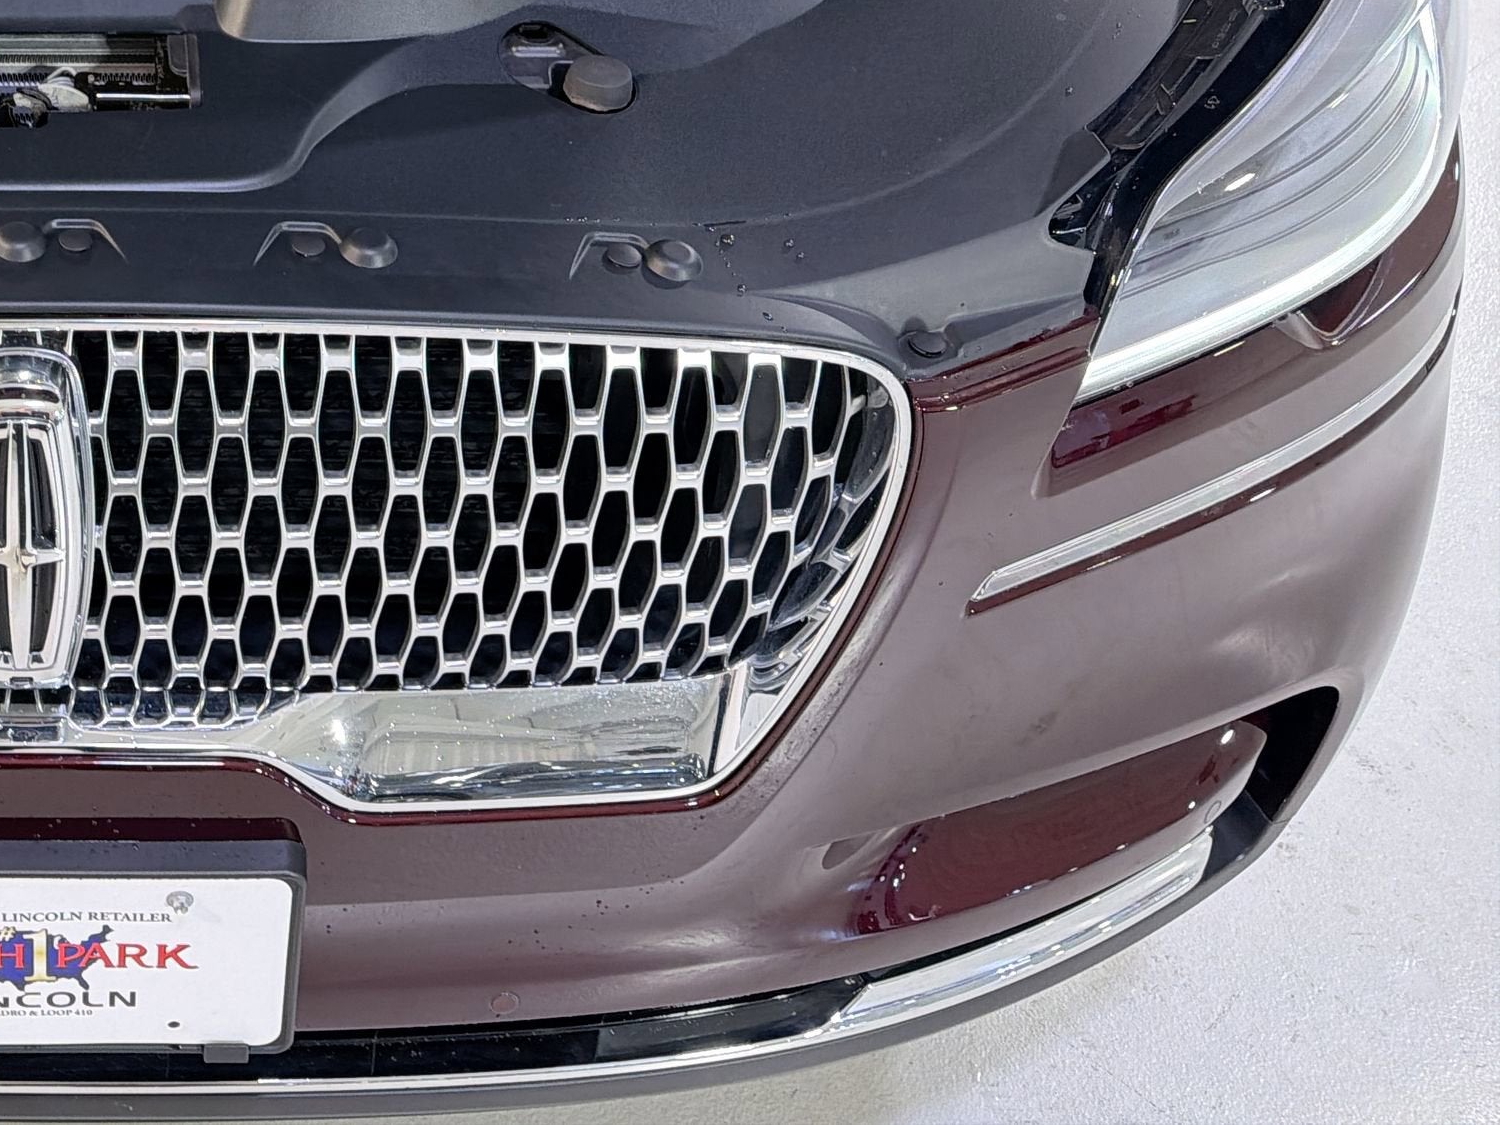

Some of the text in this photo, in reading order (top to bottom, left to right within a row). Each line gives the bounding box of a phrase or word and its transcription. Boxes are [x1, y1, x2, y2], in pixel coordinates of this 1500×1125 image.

[2, 912, 83, 922] LINCOLN
[88, 911, 172, 923] RETAILER
[56, 942, 199, 969] PARK
